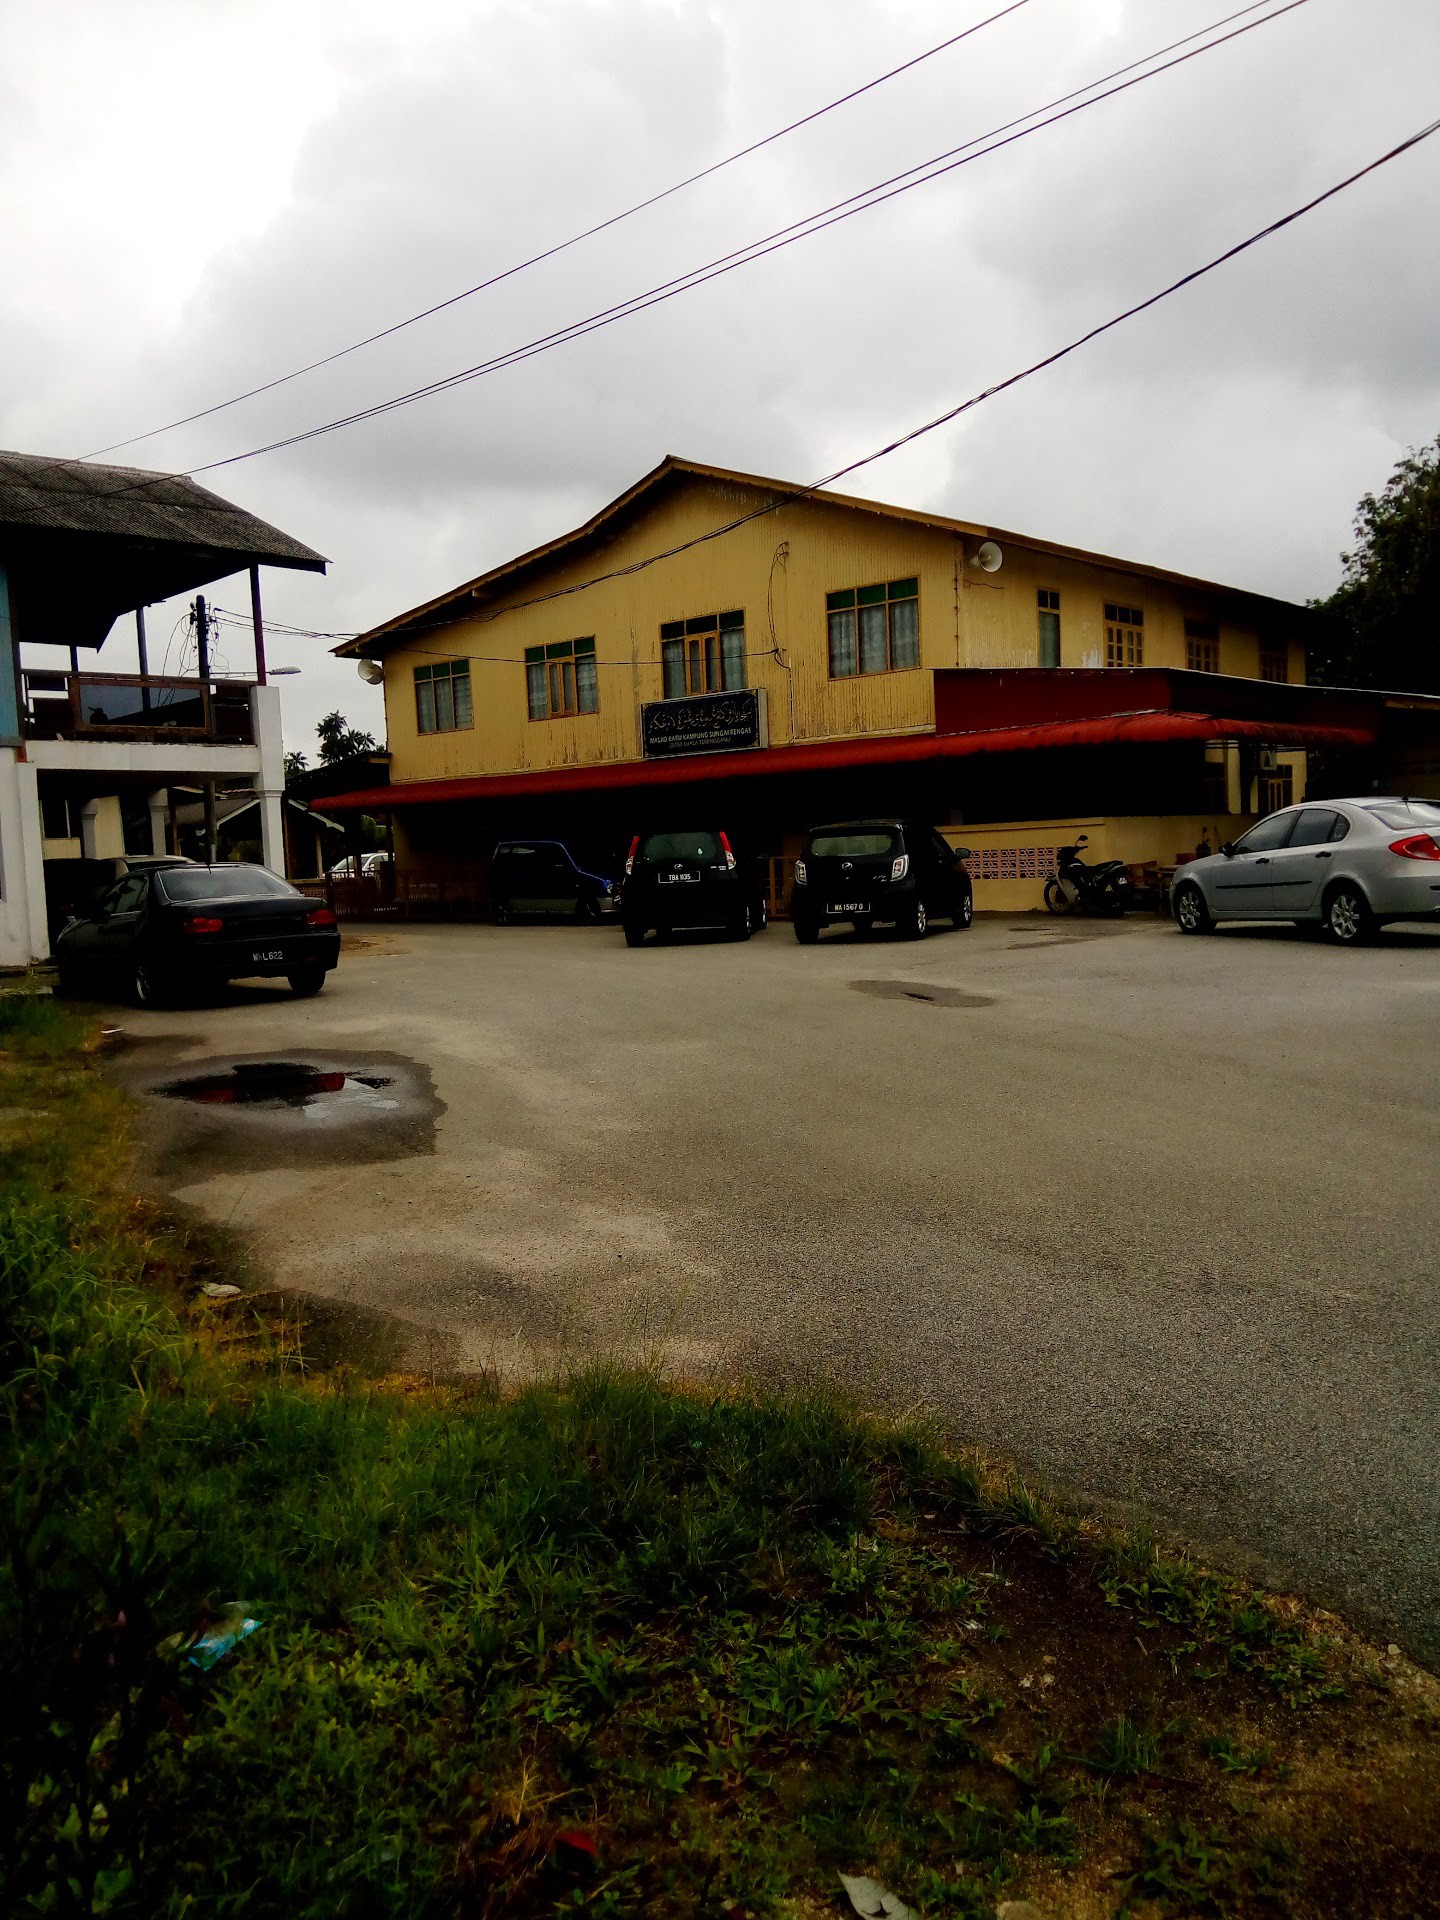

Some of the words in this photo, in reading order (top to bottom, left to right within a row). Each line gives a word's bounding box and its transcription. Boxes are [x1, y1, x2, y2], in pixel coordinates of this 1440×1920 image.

[650, 736, 668, 744] MASJID
[668, 734, 682, 743] BARU
[682, 731, 708, 741] KAMPUNG
[709, 729, 729, 738] SUNGAI
[730, 727, 751, 736] RENGAS
